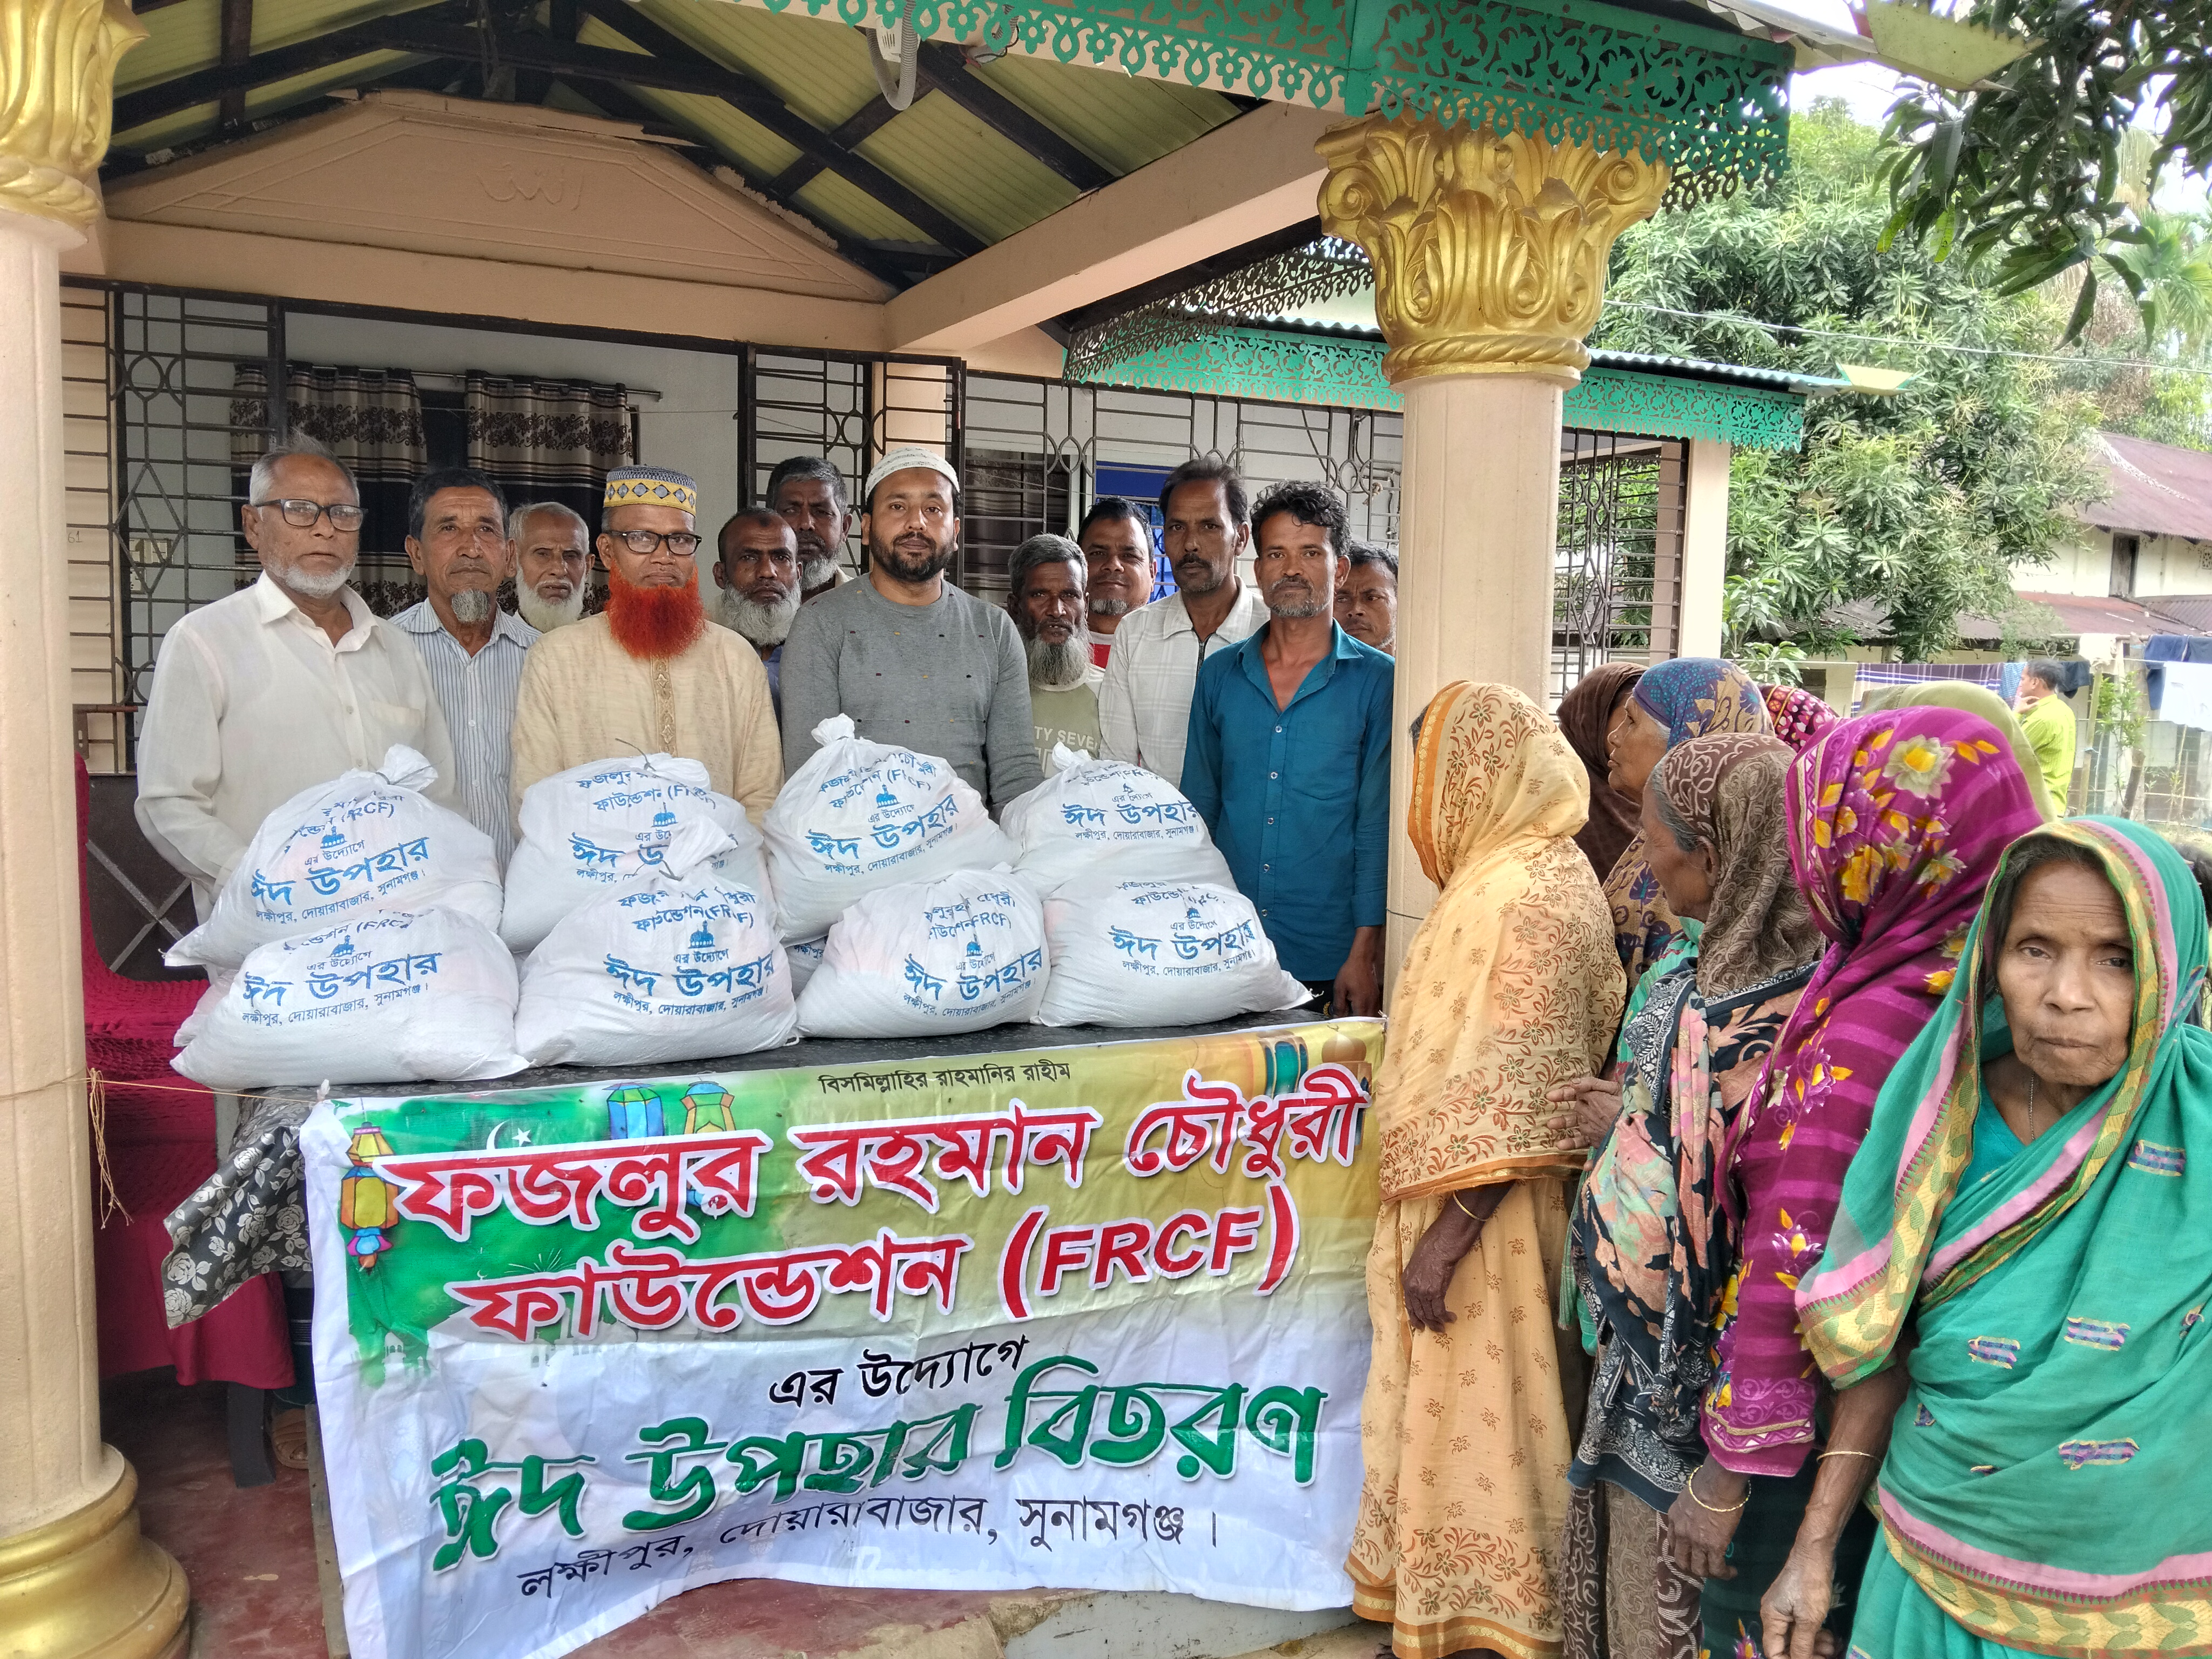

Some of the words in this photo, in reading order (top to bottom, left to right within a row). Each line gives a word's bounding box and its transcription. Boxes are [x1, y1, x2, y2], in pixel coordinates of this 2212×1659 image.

[1034, 725, 1053, 741] TY
[635, 831, 651, 842] এর
[805, 828, 862, 860] ঈদ
[869, 793, 960, 849] উপহার
[1061, 803, 1108, 828] ঈদ
[1115, 800, 1199, 825] উপহার
[251, 868, 296, 906] ঈদ
[305, 836, 430, 895] উপহার
[568, 832, 626, 868] ঈদ
[1107, 924, 1162, 961] ঈদ
[1170, 919, 1256, 960] উপহার
[1170, 921, 1185, 930] এর
[304, 952, 443, 1000] উপহার
[307, 961, 327, 970] এর
[603, 953, 664, 997] ঈদ
[671, 950, 774, 997] উপহার
[904, 953, 948, 1001] ঈদ
[955, 946, 1042, 1001] উপহার
[818, 1069, 928, 1094] বিসমিল্লাহির
[933, 1063, 1015, 1088] রাহমানির
[1020, 1059, 1070, 1083] রাহীম
[374, 1132, 770, 1242] ফজলুর
[791, 1101, 1099, 1211] রহমান
[1126, 1066, 1370, 1179] চৌধুরী
[446, 1228, 972, 1341] ফাউন্ডেশন
[998, 1179, 1300, 1322] (FRCF)
[769, 1368, 843, 1408] এর
[857, 1334, 1030, 1398] উদ্যোগে
[430, 1438, 597, 1572] ঈদ
[622, 1404, 983, 1533] উপহার
[995, 1355, 1330, 1486] বিতরণ
[720, 1493, 999, 1546] দোয়ারাবাজার,
